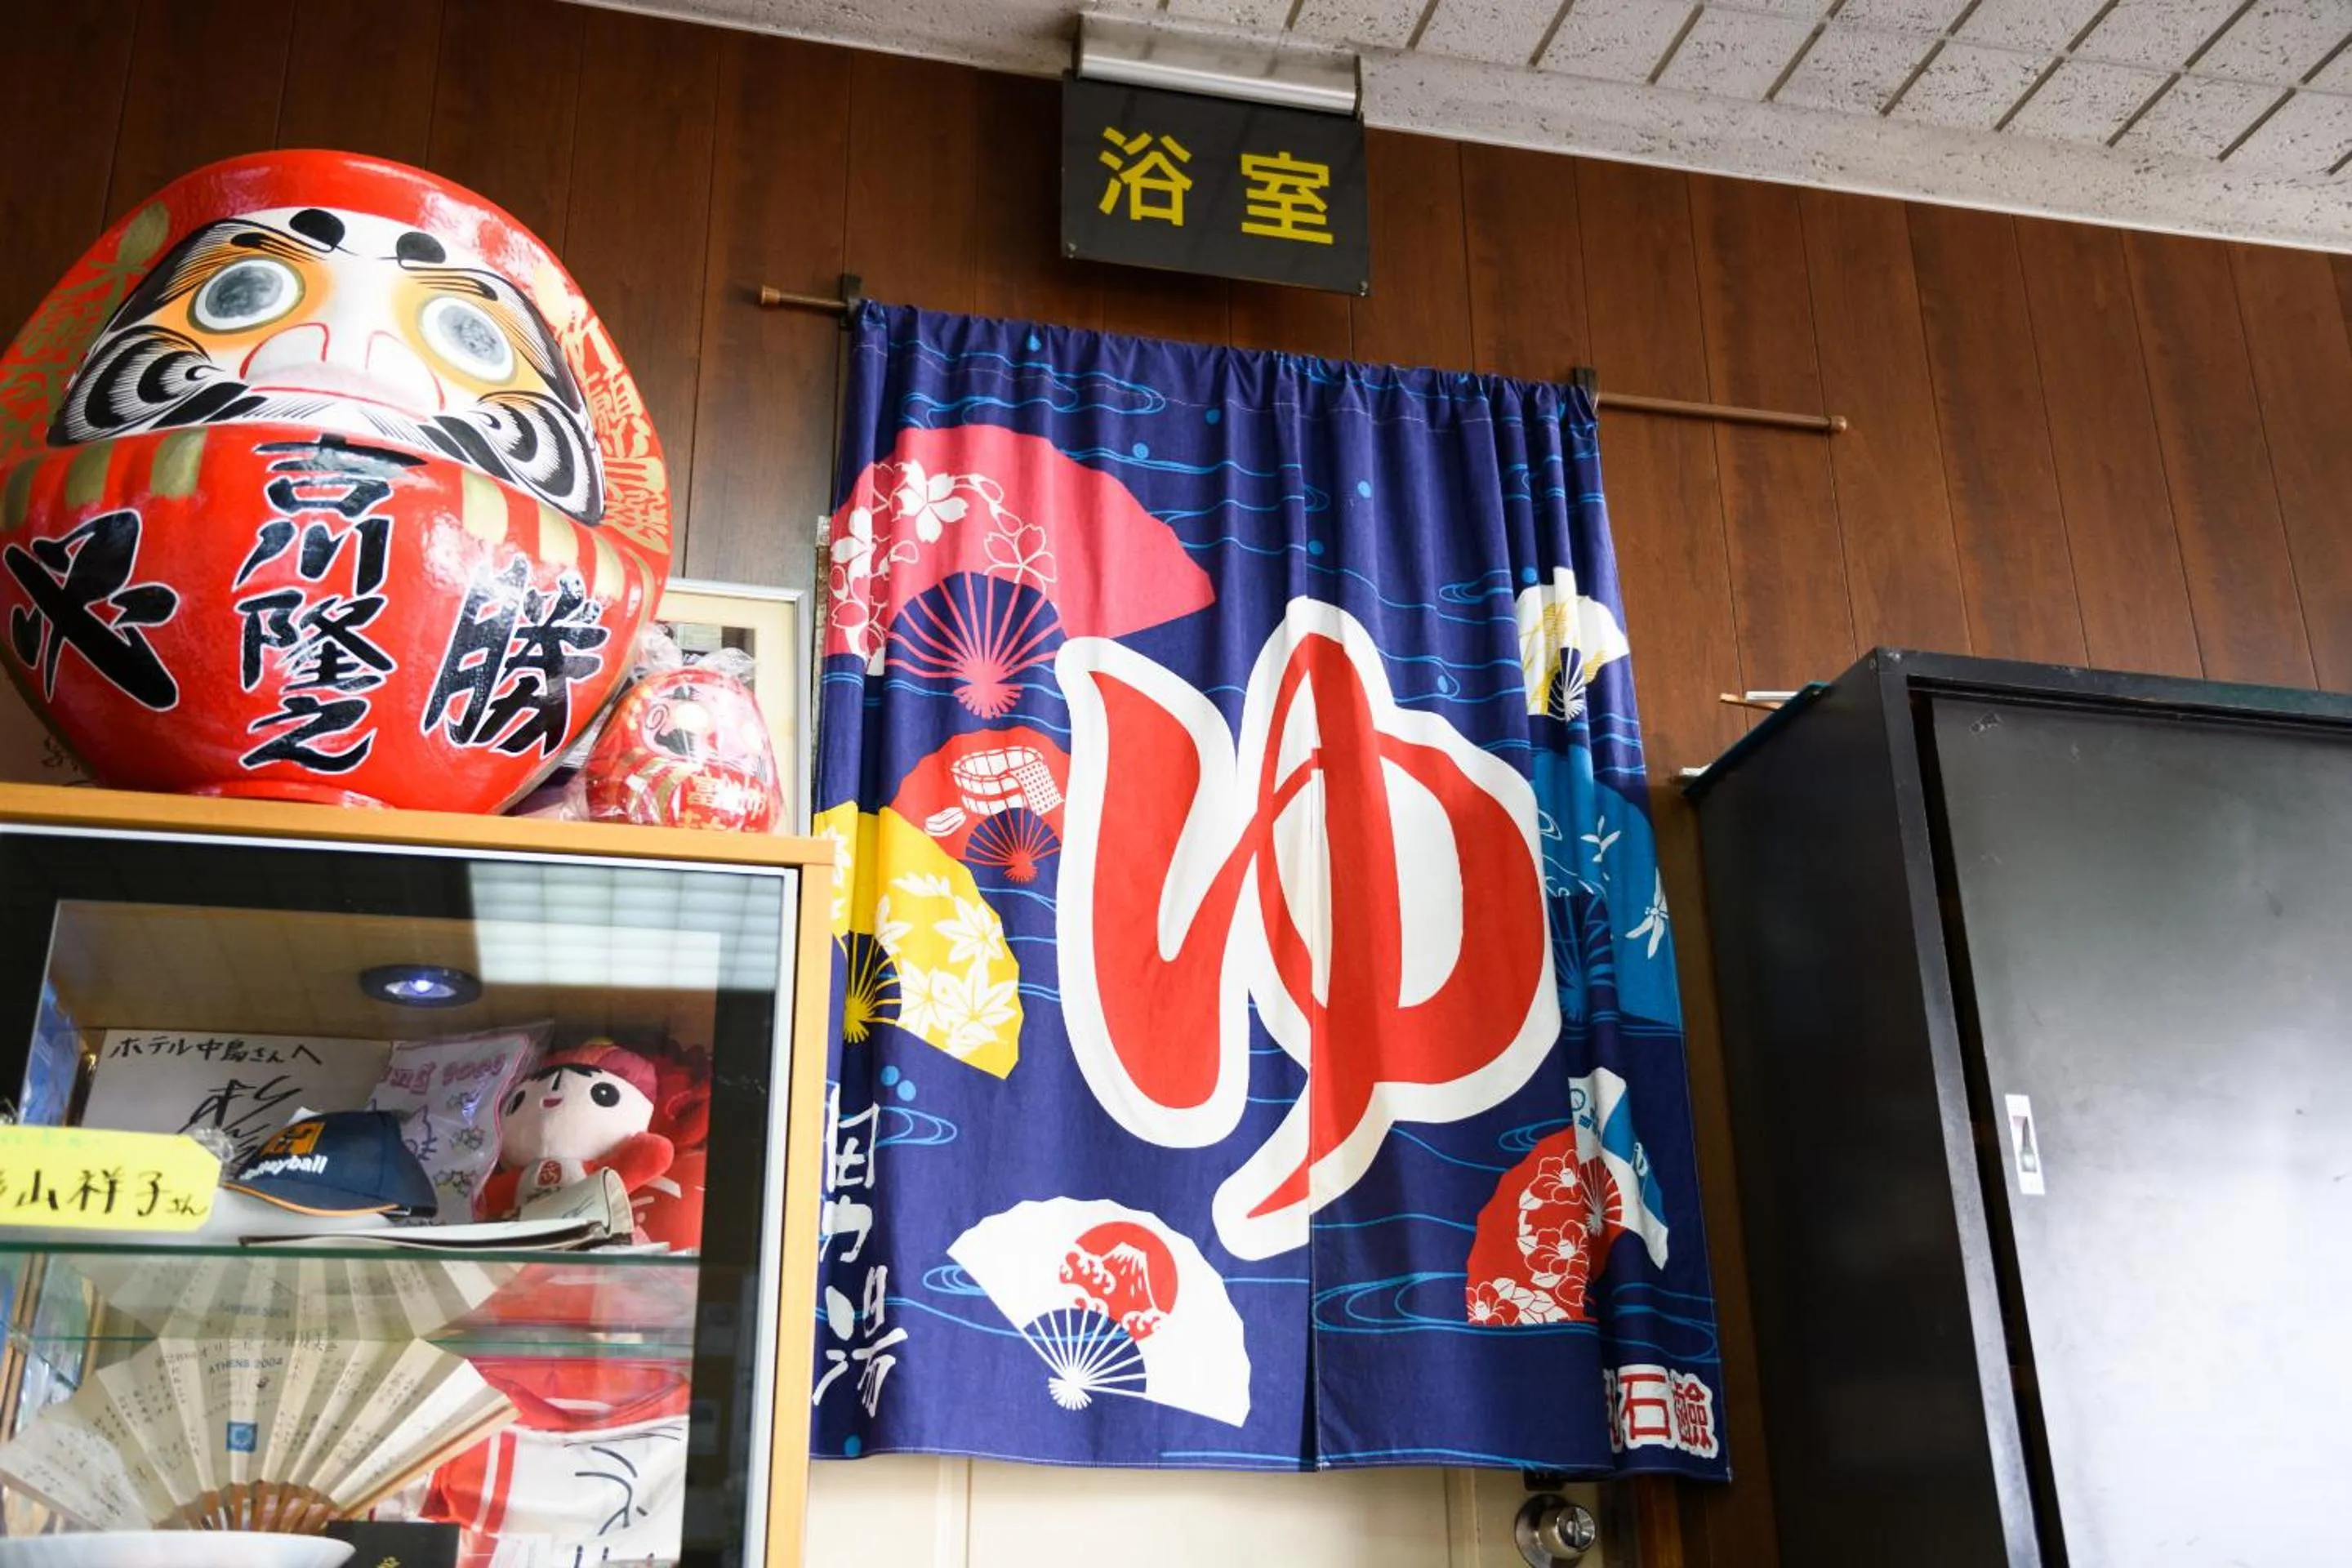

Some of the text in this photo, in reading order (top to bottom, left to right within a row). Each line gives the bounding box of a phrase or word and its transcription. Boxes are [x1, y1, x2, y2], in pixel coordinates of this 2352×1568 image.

[1098, 126, 1334, 244] 浴室
[2, 510, 180, 712] 必
[420, 554, 612, 758] 勝
[1055, 595, 1561, 1260] ゆ
[109, 1036, 323, 1066] ホテル中島さんへ
